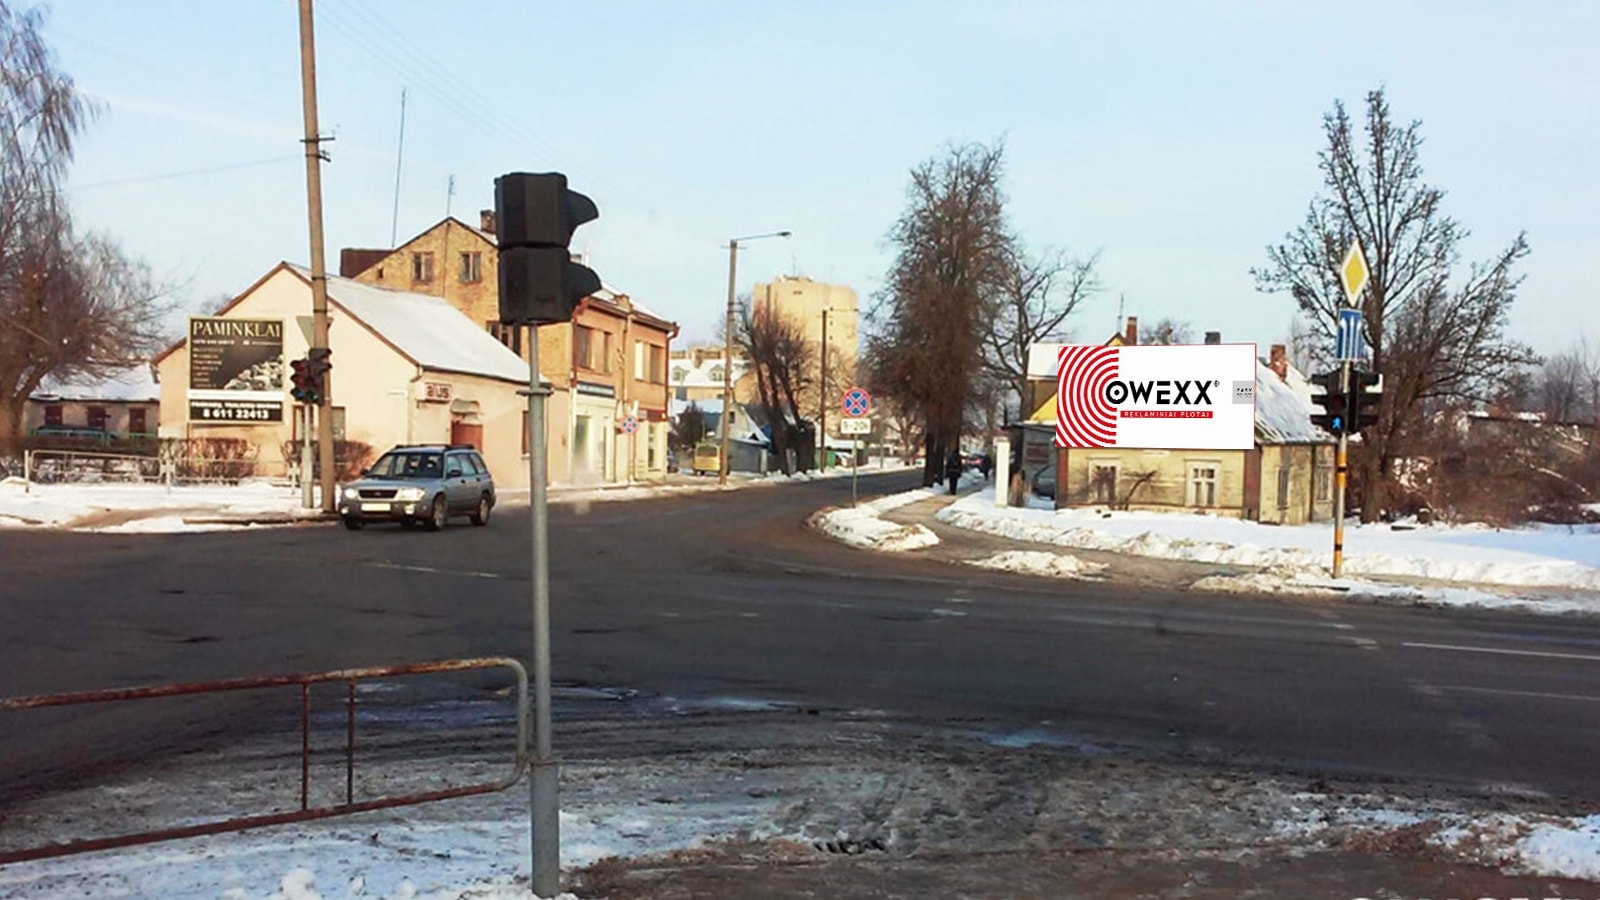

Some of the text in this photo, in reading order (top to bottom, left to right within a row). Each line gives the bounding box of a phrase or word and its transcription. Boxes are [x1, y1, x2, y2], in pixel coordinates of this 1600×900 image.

[192, 321, 280, 337] PAMINKLAI
[1105, 380, 1213, 405] OWEXX
[203, 408, 269, 419] 8 611 22413
